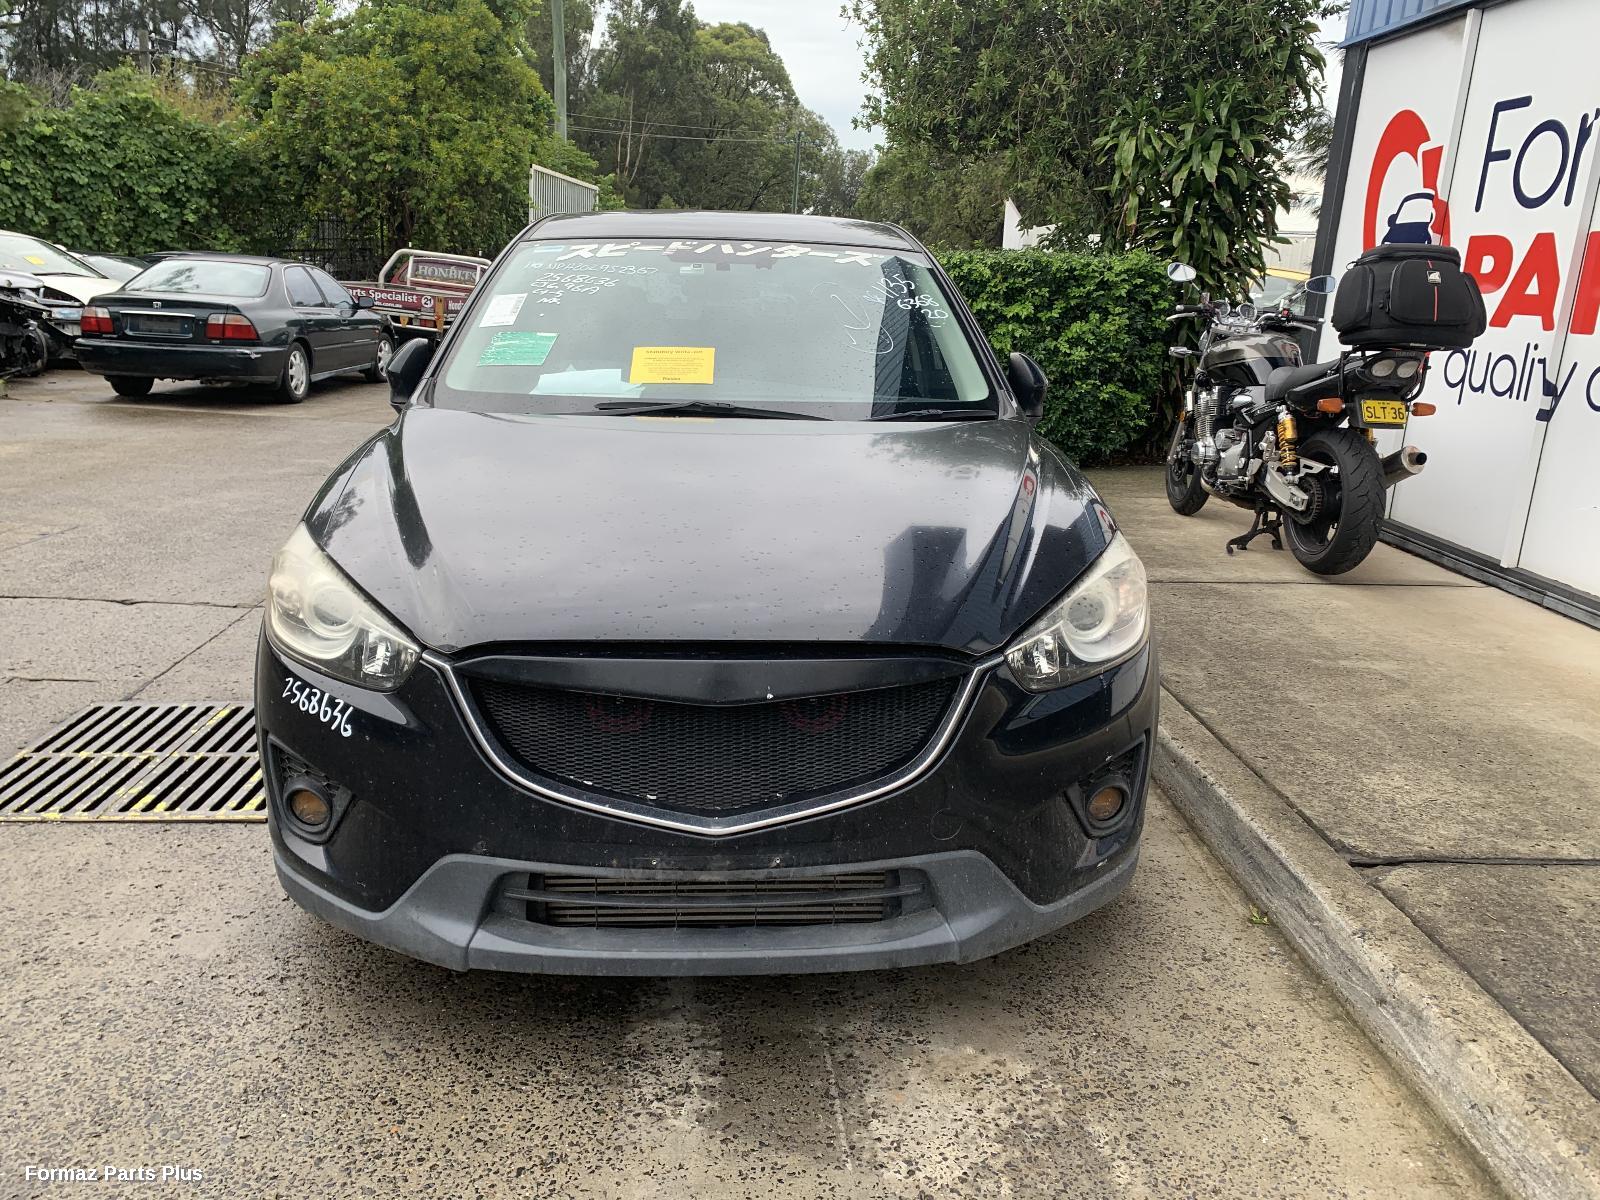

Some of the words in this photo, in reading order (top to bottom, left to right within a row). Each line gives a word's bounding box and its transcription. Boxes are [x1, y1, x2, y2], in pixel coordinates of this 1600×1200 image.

[369, 289, 418, 303] Specialist
[1444, 342, 1578, 422] quality
[282, 677, 354, 738] 2568636
